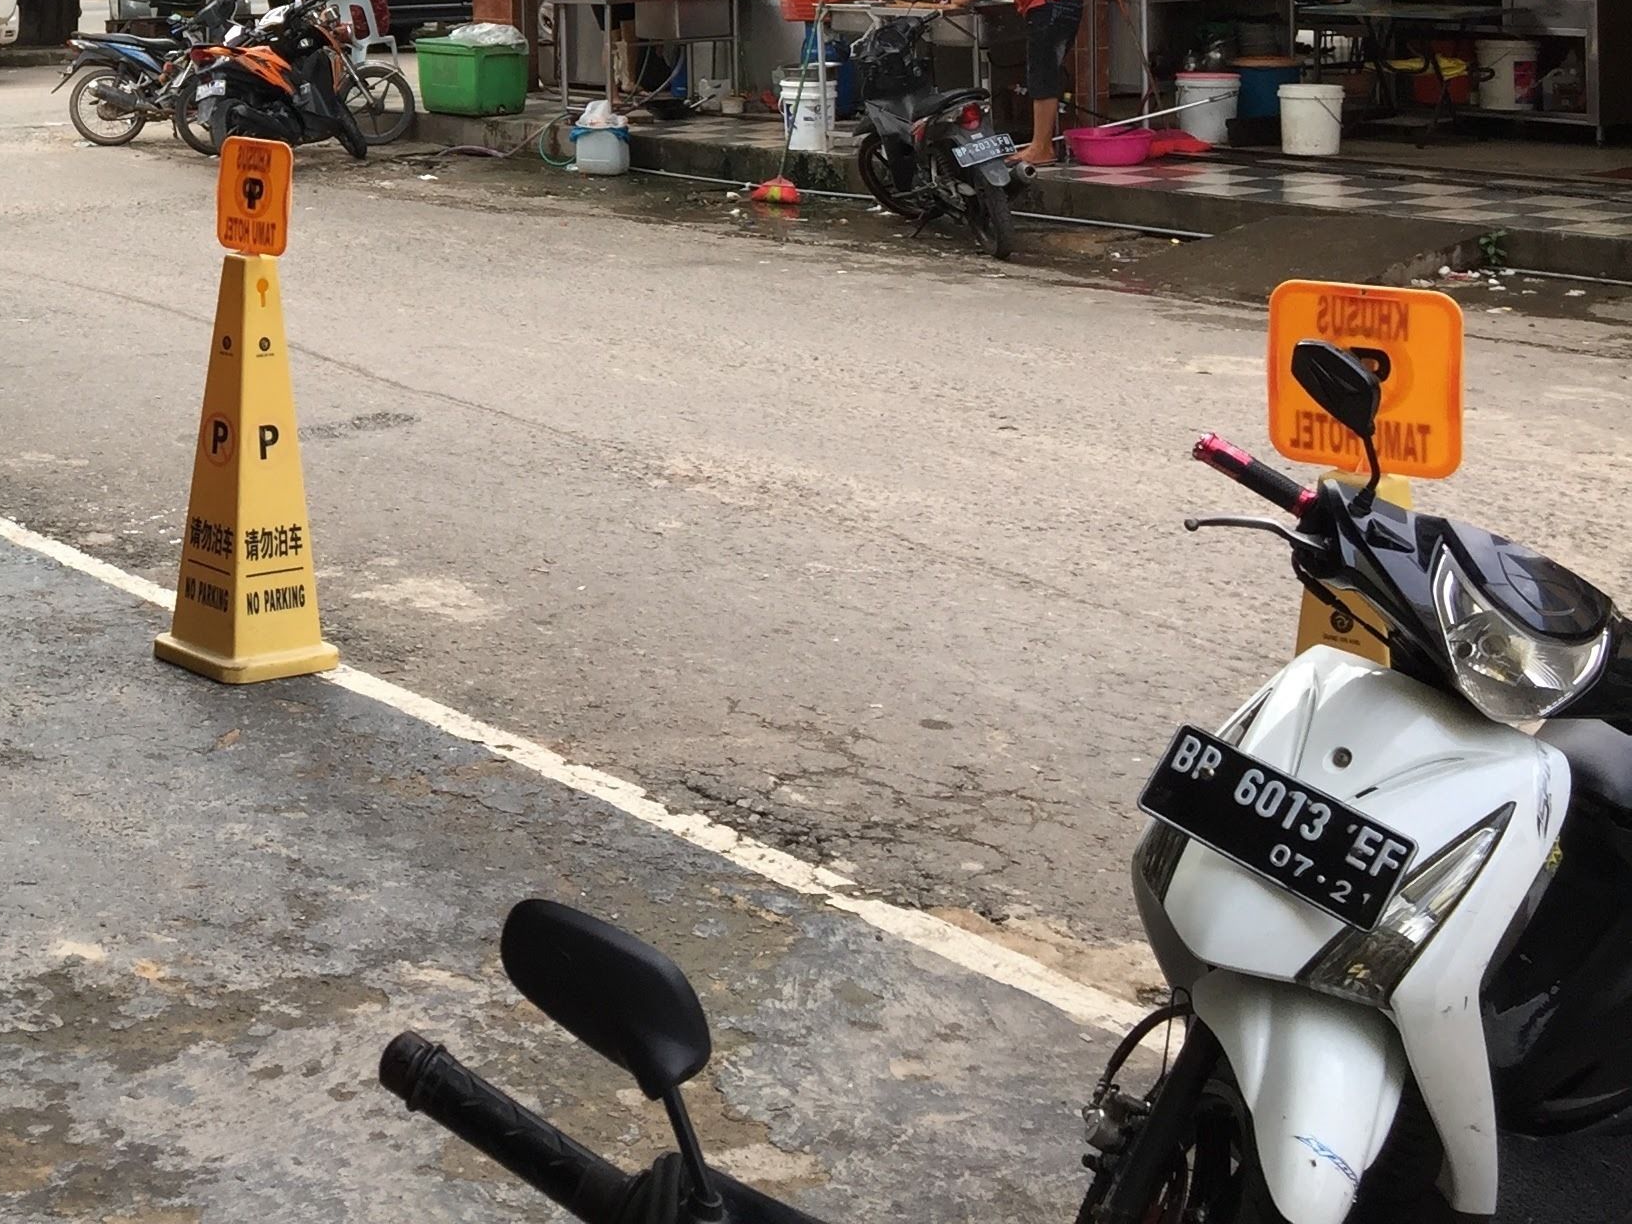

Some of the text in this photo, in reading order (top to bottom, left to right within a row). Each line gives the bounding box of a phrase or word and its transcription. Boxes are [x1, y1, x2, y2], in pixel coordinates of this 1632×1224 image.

[189, 516, 235, 560] 请勿泊车
[244, 523, 304, 562] 请勿泊车
[184, 576, 229, 614] NO PARKING
[246, 583, 306, 616] NO PARKING
[1170, 734, 1223, 781] BP
[1233, 767, 1332, 842] 6013
